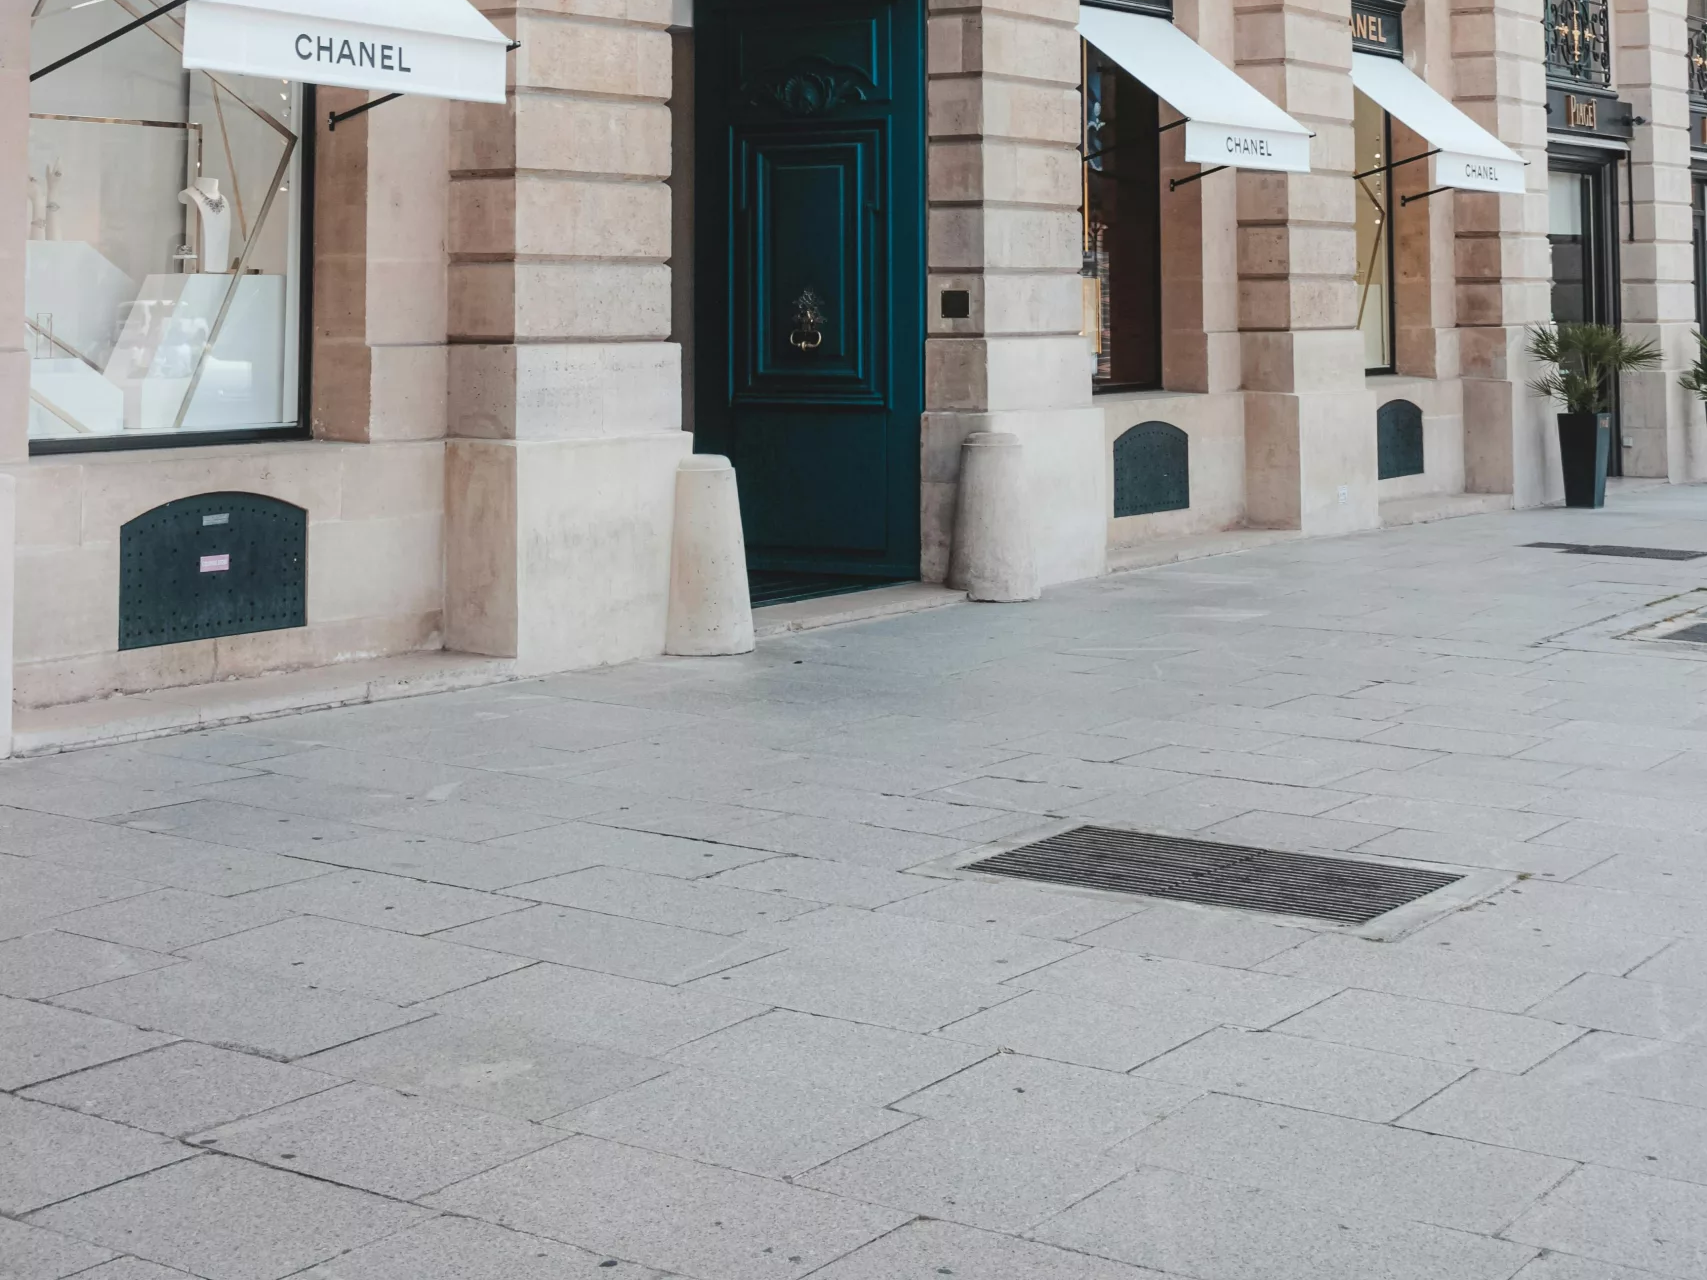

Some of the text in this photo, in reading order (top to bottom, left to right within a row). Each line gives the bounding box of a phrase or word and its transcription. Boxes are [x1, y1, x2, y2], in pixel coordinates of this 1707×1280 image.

[295, 33, 412, 73] CHANEL
[1566, 94, 1598, 131] PIAGET
[1226, 136, 1272, 157] CHANEL
[1465, 163, 1498, 181] CHANEL
